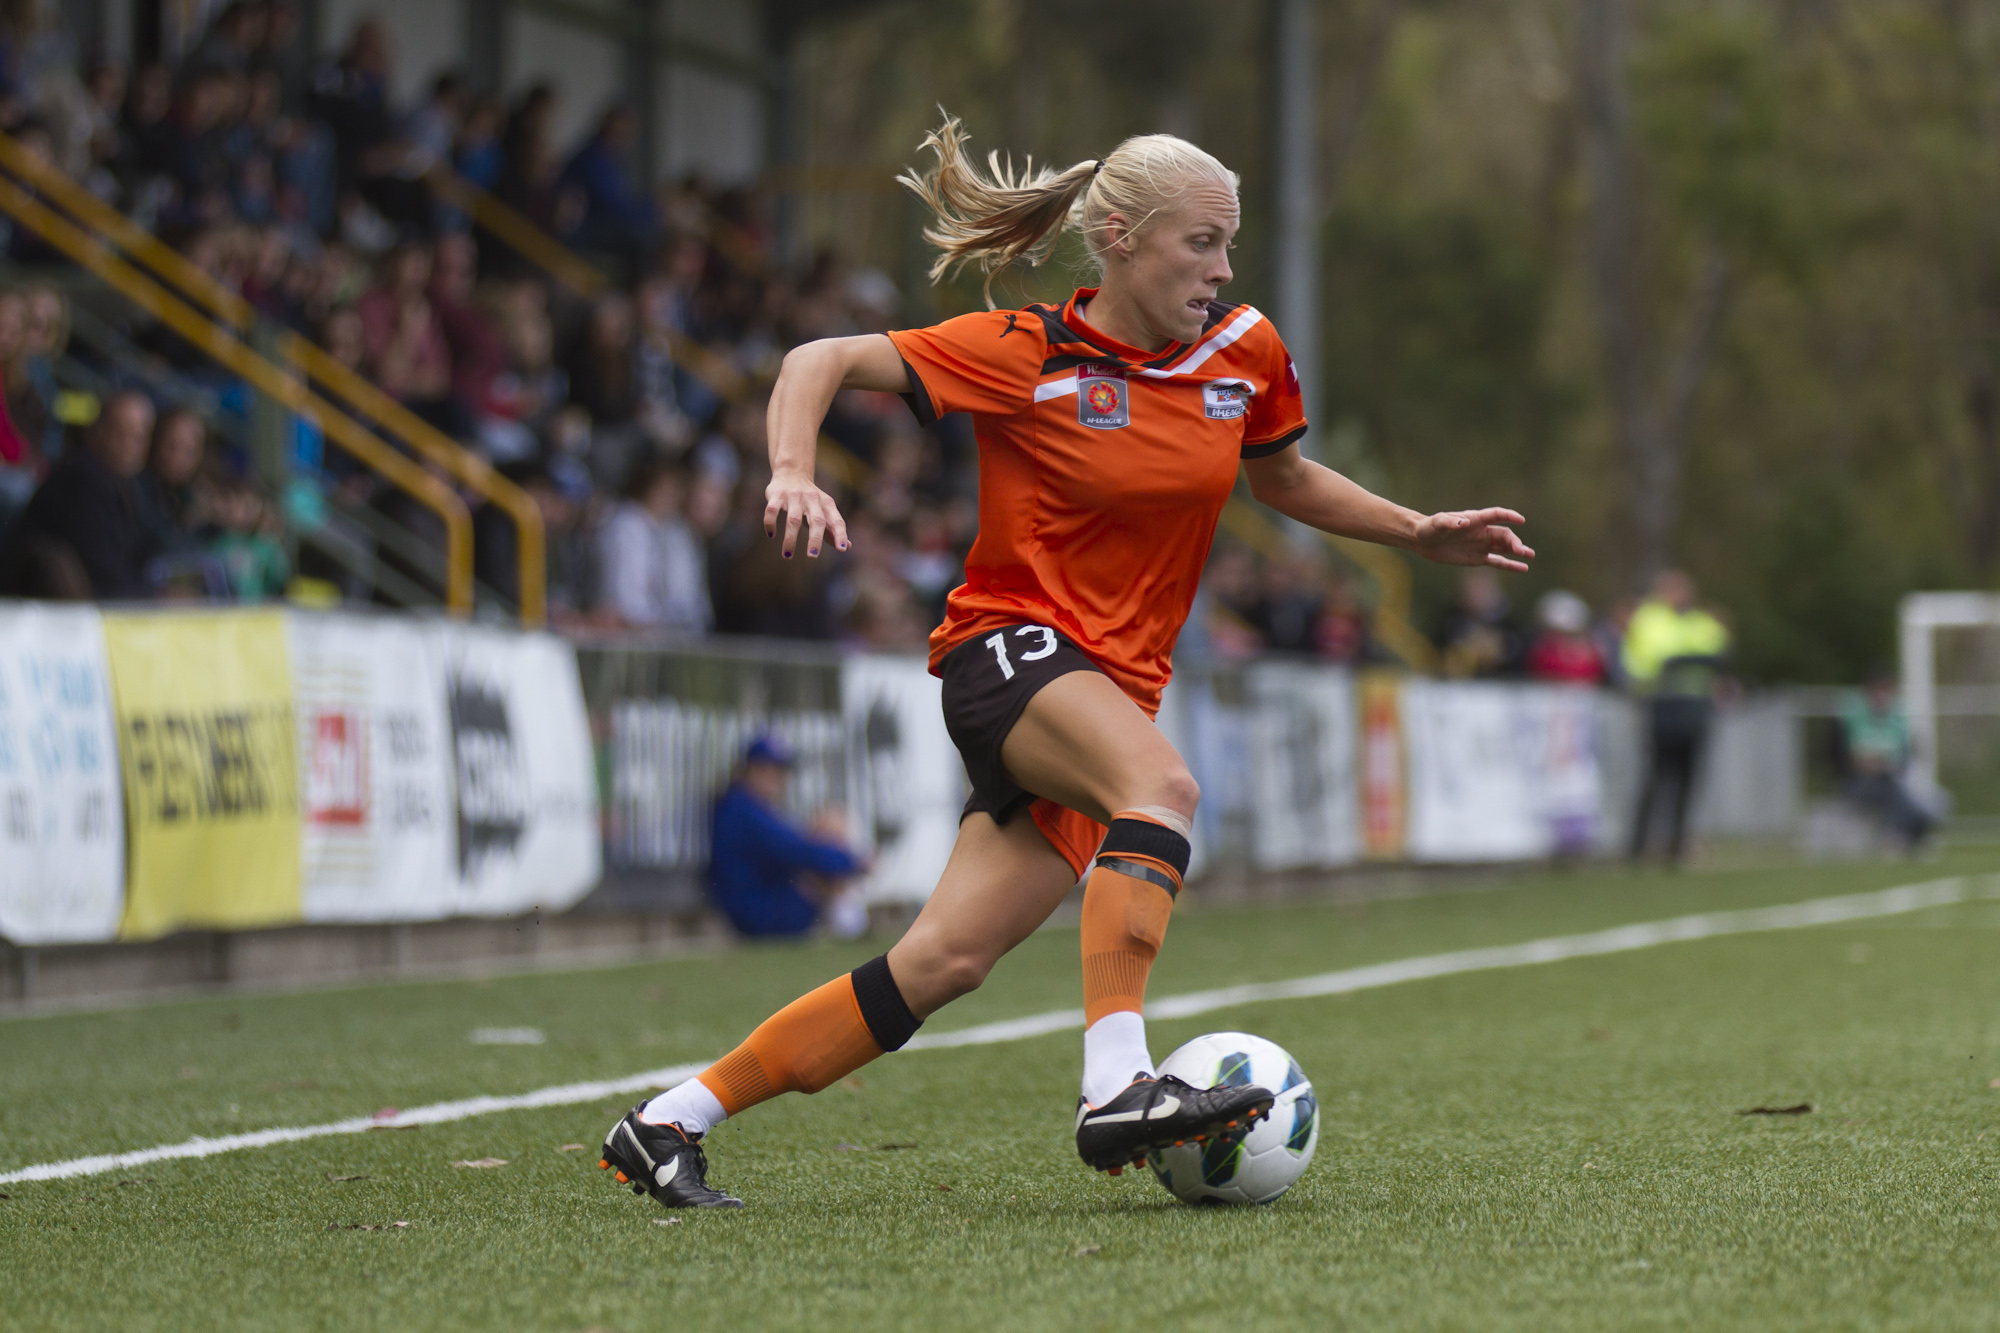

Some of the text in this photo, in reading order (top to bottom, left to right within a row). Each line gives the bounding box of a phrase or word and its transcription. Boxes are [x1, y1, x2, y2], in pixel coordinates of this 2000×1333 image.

[1086, 364, 1118, 376] Westfield
[1086, 417, 1123, 425] W-LEAGUE
[985, 625, 1058, 681] 13
